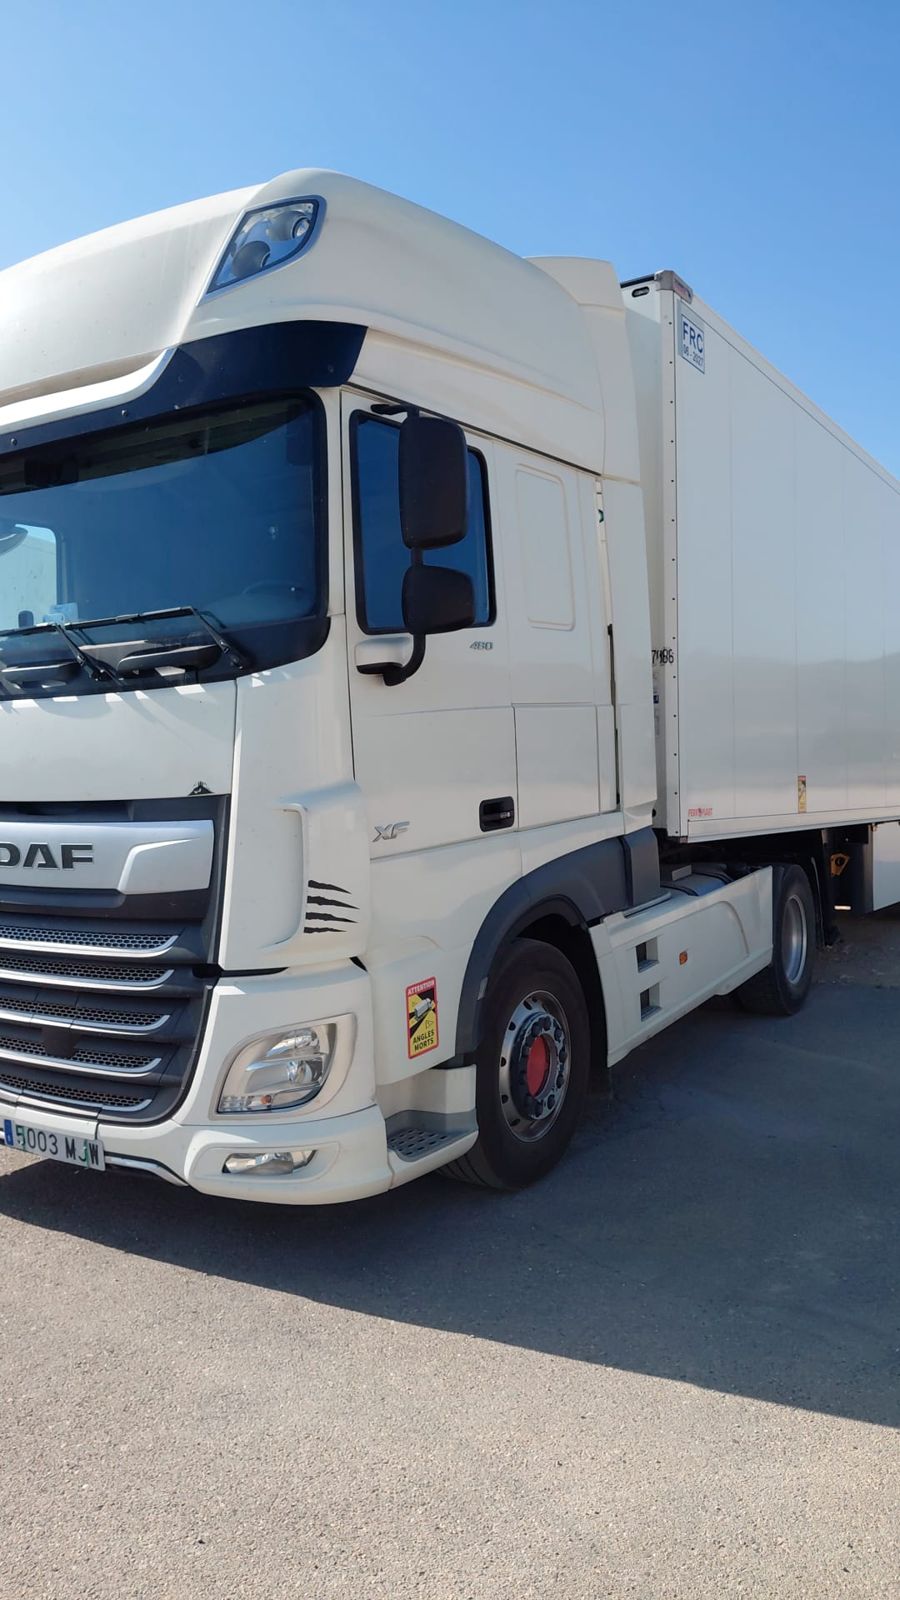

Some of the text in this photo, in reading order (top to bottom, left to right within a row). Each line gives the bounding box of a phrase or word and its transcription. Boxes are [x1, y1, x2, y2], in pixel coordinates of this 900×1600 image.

[683, 320, 703, 353] FRC
[372, 821, 410, 842] XF
[0, 842, 93, 870] DAF
[408, 979, 435, 996] ATTENTION
[413, 1029, 435, 1044] ANGLES
[414, 1038, 434, 1053] MORTS
[15, 1124, 99, 1166] 5003 MJW
